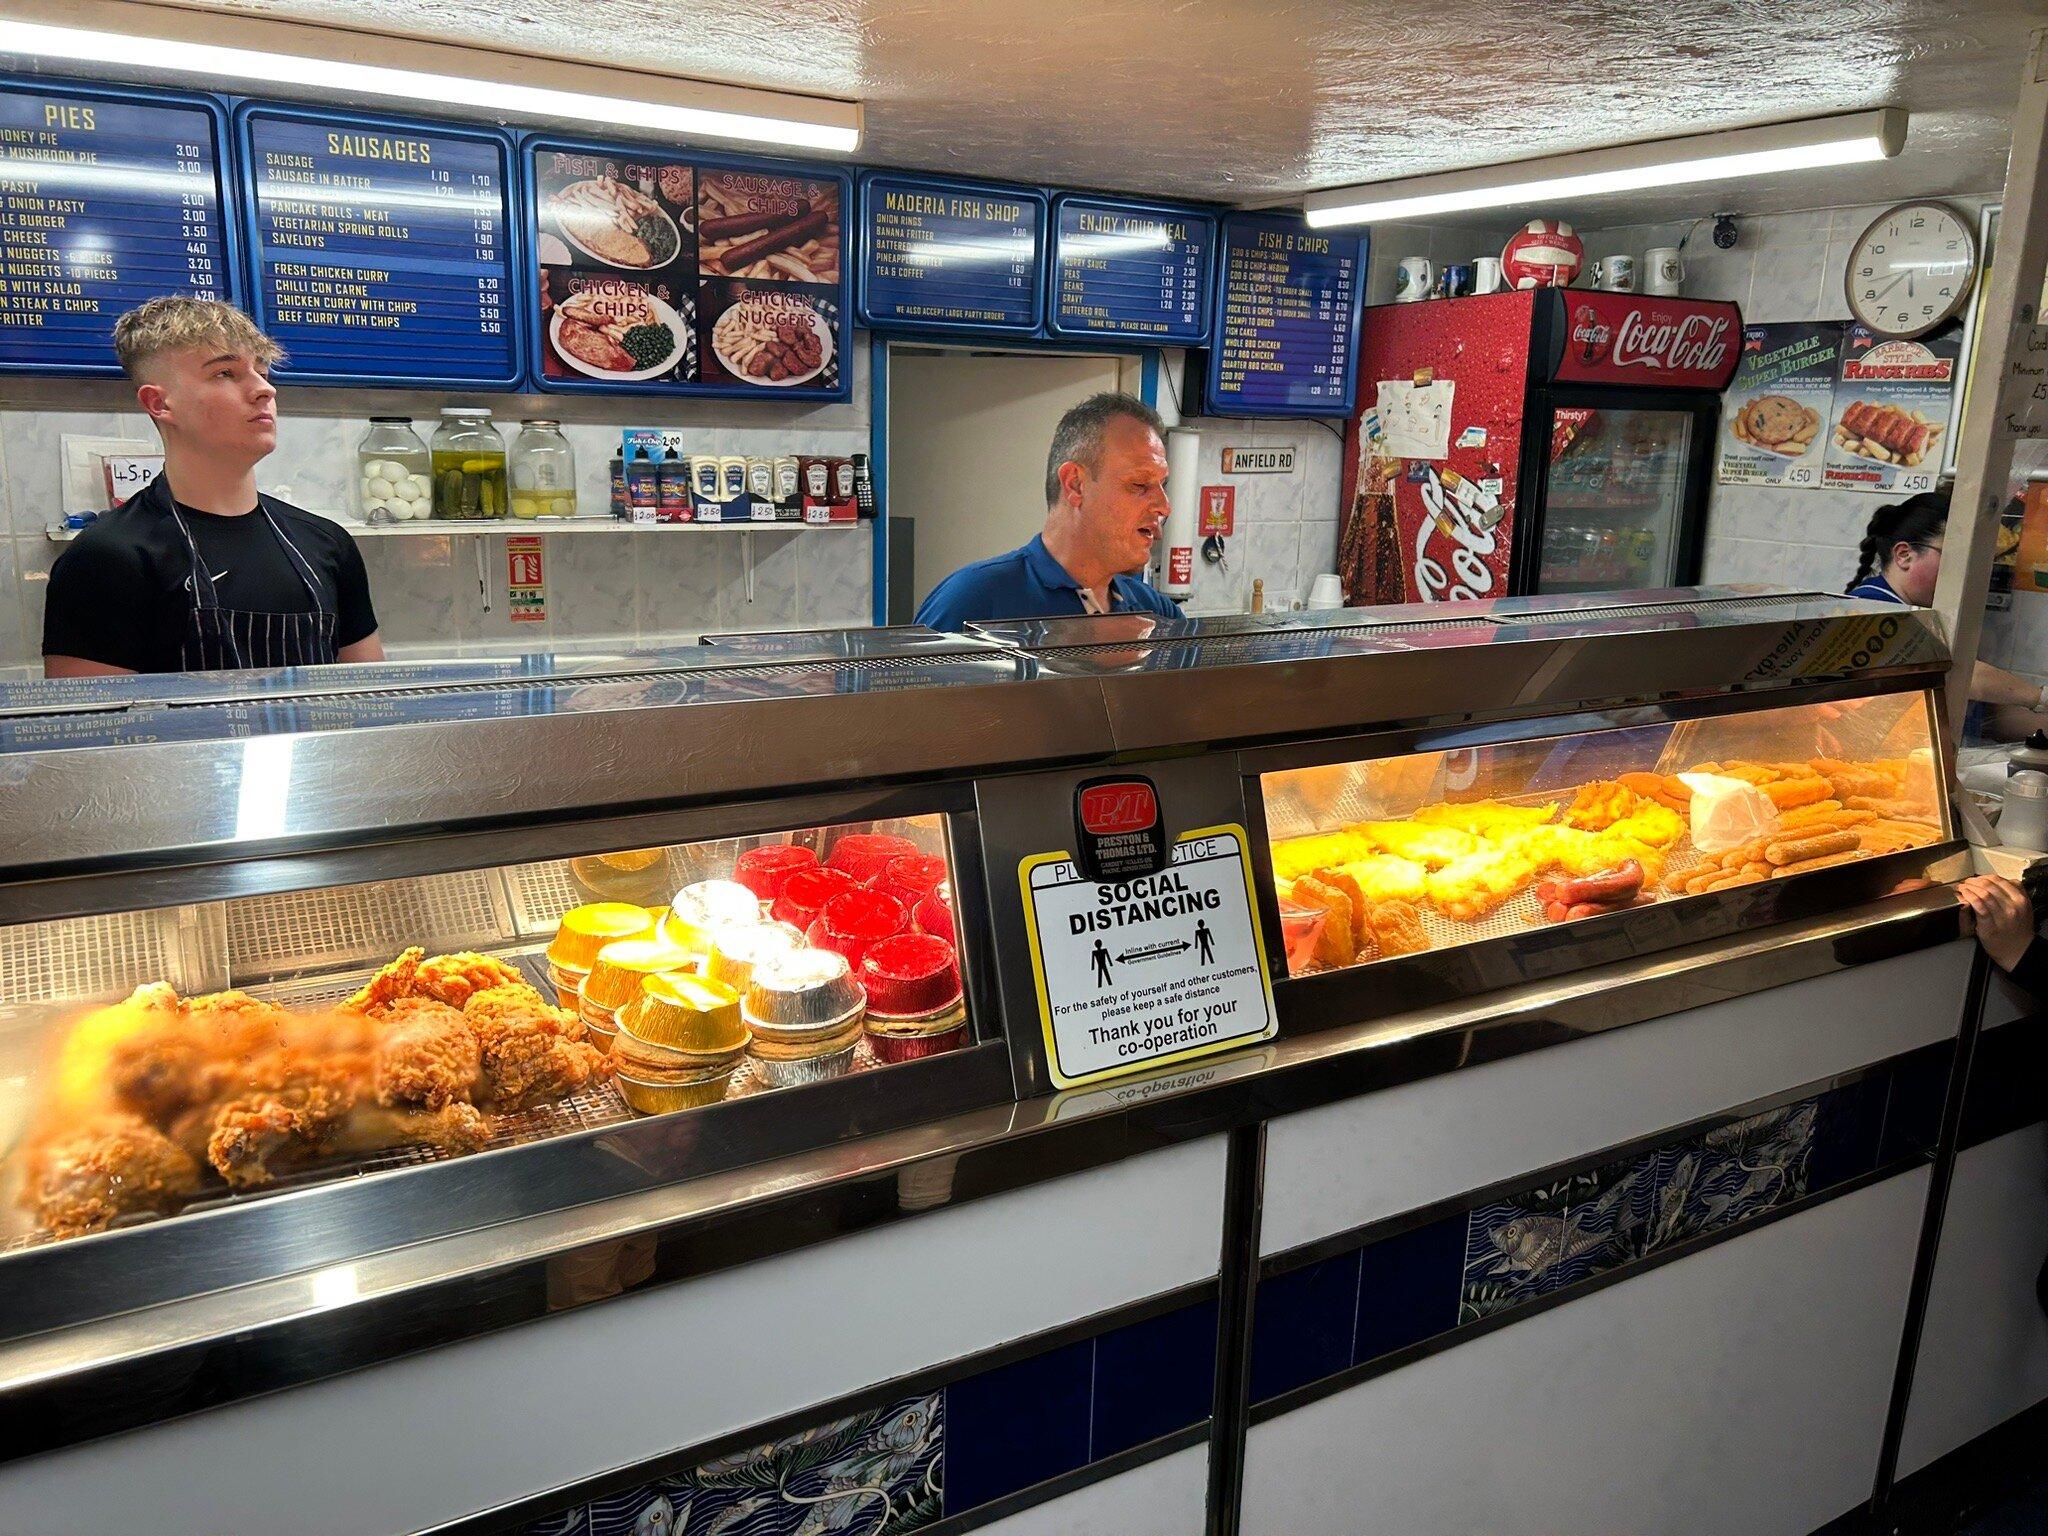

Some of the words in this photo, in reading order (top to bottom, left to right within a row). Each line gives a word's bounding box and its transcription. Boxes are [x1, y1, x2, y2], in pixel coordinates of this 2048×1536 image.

[45, 104, 95, 130] PIES
[328, 134, 430, 164] SAUSAGES
[9, 147, 75, 163] MUSHROOM
[80, 152, 97, 165] PIE
[178, 161, 200, 173] 3.00
[267, 153, 314, 168] SAUSAGE
[432, 170, 450, 182] 1.10
[472, 174, 490, 186] 1.70
[555, 157, 598, 176] FISH
[605, 163, 619, 179] &
[625, 165, 680, 184] CHIPS
[2, 180, 38, 193] PASTY
[269, 169, 315, 184] SAUSAGE
[320, 174, 329, 184] IN
[334, 175, 370, 189] BATTER
[723, 174, 802, 197] SAUSAGE
[808, 184, 820, 197] &
[9, 197, 44, 210] ONION
[49, 200, 84, 213] PASTY
[183, 210, 205, 222] 3.00
[271, 201, 317, 216] PANCAKE
[322, 206, 352, 219] ROLLS
[364, 209, 389, 222] MEAT
[748, 198, 799, 216] CHIPS
[887, 192, 945, 215] MADERIA
[952, 200, 980, 219] FISH
[986, 204, 1019, 222] SHOP
[20, 214, 65, 228] BURGER
[183, 226, 206, 237] 3.50
[877, 214, 898, 224] ONION
[901, 216, 922, 226] RINGS
[1080, 214, 1118, 233] ENJOY
[1910, 218, 1925, 228] 12
[4, 230, 48, 244] CHEESE
[272, 216, 334, 233] VEGETARIAN
[339, 222, 374, 236] SPRING
[379, 226, 408, 239] ROLLS
[475, 233, 492, 245] 1.90
[272, 232, 324, 247] SAVELOYS
[877, 226, 904, 237] BANANA
[907, 229, 934, 240] FRITTER
[1890, 227, 1898, 236] 11
[1259, 232, 1282, 248] FISH
[1287, 235, 1293, 249] &
[1297, 236, 1329, 254] CHIPS
[1871, 245, 1885, 254] 10
[1946, 240, 1958, 250] 2
[7, 247, 59, 260] NUGGETS
[188, 258, 211, 270] 3.20
[9, 264, 61, 277] NUGGETS
[85, 268, 118, 280] PIECES
[190, 274, 212, 285] 4.50
[275, 263, 306, 276] FRESH
[311, 266, 353, 280] CHICKEN
[357, 270, 389, 282] CURRY
[479, 279, 498, 289] 6.20
[899, 268, 924, 278] COFFEE
[1064, 270, 1080, 279] PEAS
[1862, 268, 1873, 276] 9
[45, 282, 81, 295] SALAD
[276, 279, 307, 292] CHILLI
[312, 282, 331, 294] CON
[336, 284, 368, 296] CARNE
[480, 294, 498, 304] 5.50
[568, 279, 650, 298] CHICKEN
[658, 284, 670, 300] &
[1865, 290, 1875, 299] 8
[1939, 288, 1950, 296] 4
[13, 298, 48, 310] STEAK
[65, 300, 99, 312] CHIPS
[740, 291, 813, 309] CHICKEN
[594, 301, 647, 318] CHIPS
[738, 310, 816, 327] NUGGETS
[1652, 312, 1672, 324] Enjoy
[1877, 306, 1887, 315] 7
[1898, 313, 1909, 322] 6
[1922, 306, 1933, 314] 5
[278, 310, 302, 322] BEEF
[306, 312, 339, 325] CURRY
[343, 314, 367, 326] WITH
[371, 316, 400, 328] CHIPS
[482, 322, 500, 333] 5.50
[1573, 324, 1610, 343] Coca-Cola
[1613, 310, 1730, 370] Coca-Cola
[1747, 336, 1820, 371] VEGETABLE
[1779, 347, 1836, 377] BURGER
[1883, 355, 1912, 363] STYLE
[1556, 410, 1586, 422] Thirsty?
[1235, 454, 1276, 468] ANFIELD
[1279, 454, 1292, 467] RD
[1097, 834, 1141, 848] PRESTON
[1143, 832, 1149, 842] &
[1055, 864, 1078, 882] PL
[1172, 840, 1218, 863] CTICE
[1096, 846, 1136, 860] THOMAS
[1137, 844, 1157, 854] LTD.
[1097, 873, 1189, 905] SOCIAL
[1069, 889, 1221, 935] DISTANCING
[1125, 946, 1142, 954] Inline
[1144, 943, 1157, 951] with
[1158, 939, 1180, 949] current
[1127, 955, 1156, 965] Government
[1157, 951, 1181, 960] Guidelines
[1055, 1006, 1070, 1016] For
[1073, 1001, 1088, 1012] the
[1090, 995, 1118, 1008] safety
[1120, 991, 1129, 1001] of
[1131, 982, 1168, 1000] yourself
[1170, 979, 1186, 990] and
[1188, 975, 1210, 987] other
[1212, 965, 1257, 982] customers,
[1102, 1007, 1131, 1021] please
[1133, 1000, 1155, 1013] keep
[1164, 993, 1183, 1005] safe
[1185, 985, 1220, 999] distance
[1089, 1020, 1141, 1045] Thank
[1144, 1014, 1174, 1035] you
[1178, 1008, 1199, 1024] for
[1203, 999, 1237, 1021] your
[1118, 1022, 1217, 1056] co-operation
